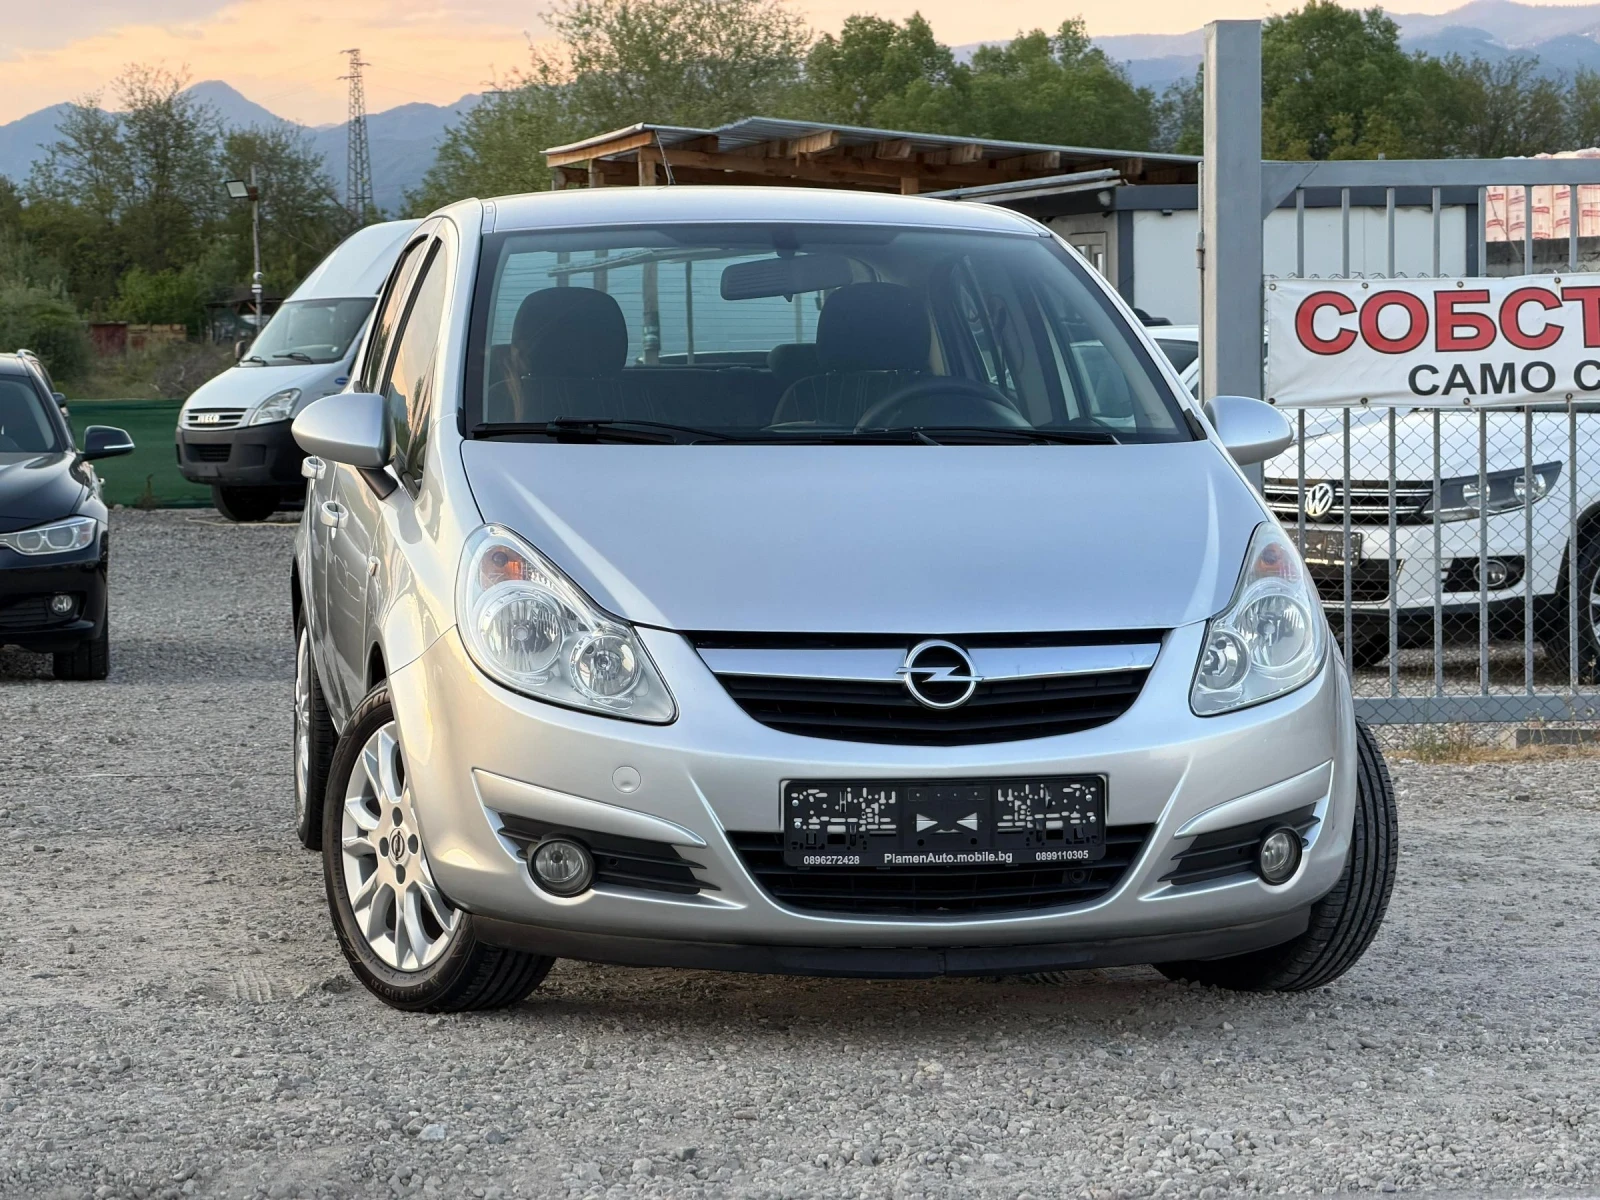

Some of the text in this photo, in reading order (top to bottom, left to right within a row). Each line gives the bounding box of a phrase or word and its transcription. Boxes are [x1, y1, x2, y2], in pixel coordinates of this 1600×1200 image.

[1295, 286, 1600, 356] СОБСТ
[1408, 361, 1556, 396] САМО
[803, 850, 1089, 865] 0896272428 PlamenAuto.mobile.bg 0899110305
